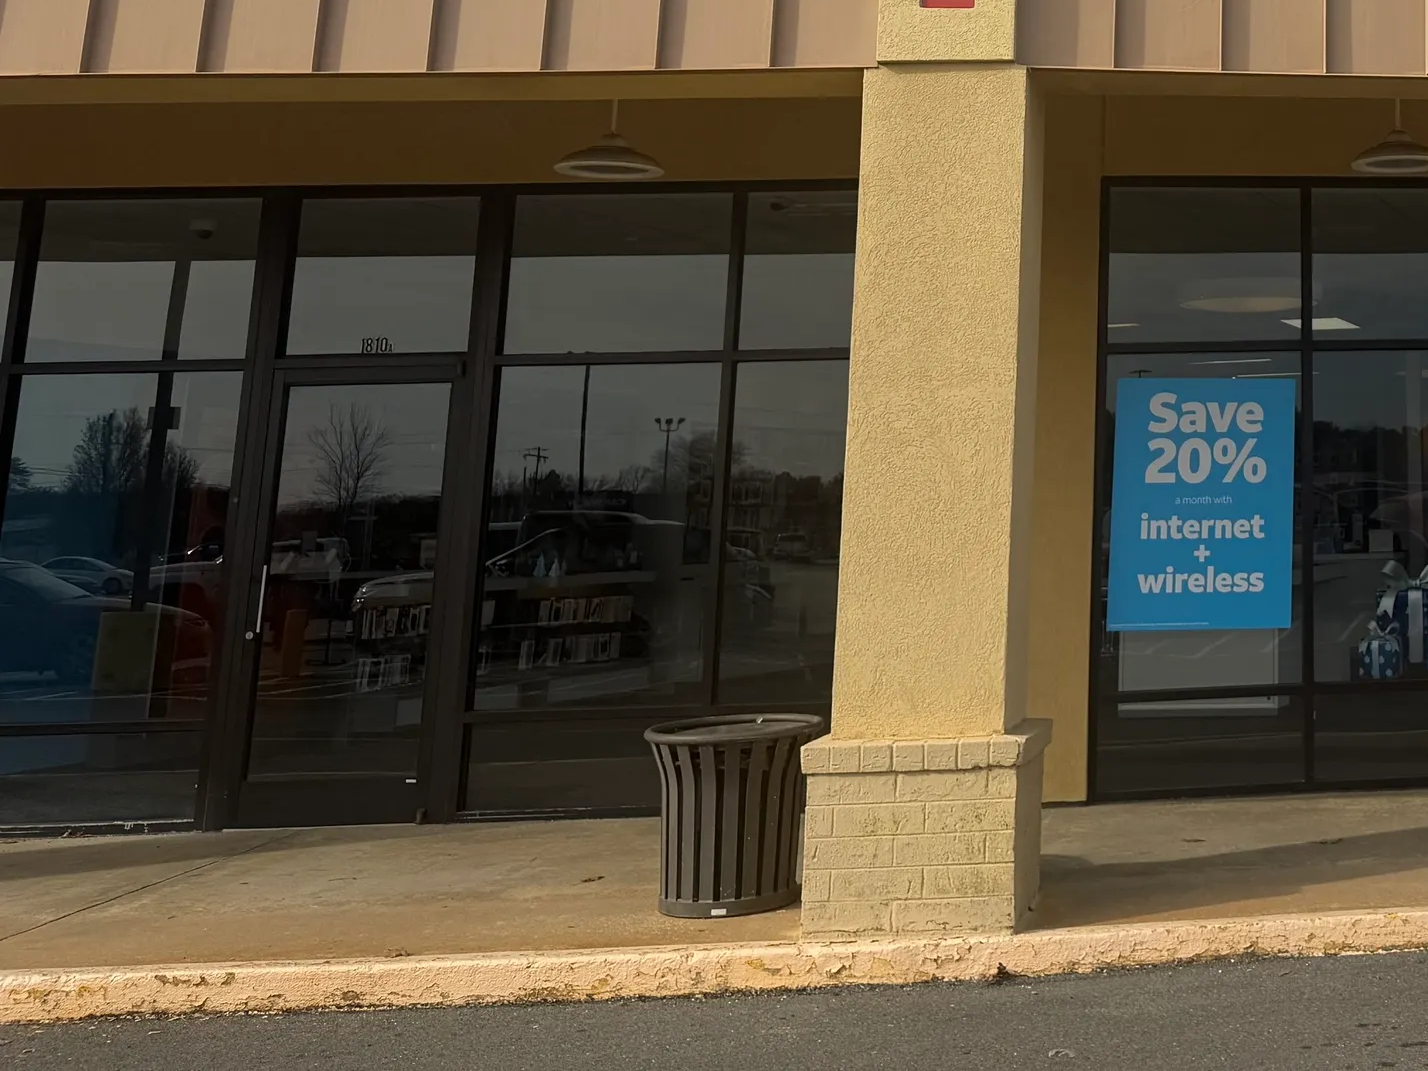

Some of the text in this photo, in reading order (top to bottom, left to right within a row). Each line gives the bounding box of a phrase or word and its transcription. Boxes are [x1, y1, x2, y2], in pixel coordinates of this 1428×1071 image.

[1147, 392, 1265, 433] Save
[1144, 437, 1267, 484] 20%
[1182, 495, 1212, 505] month
[1213, 495, 1233, 504] with
[1140, 513, 1265, 540] internet
[1137, 566, 1265, 594] wireless
